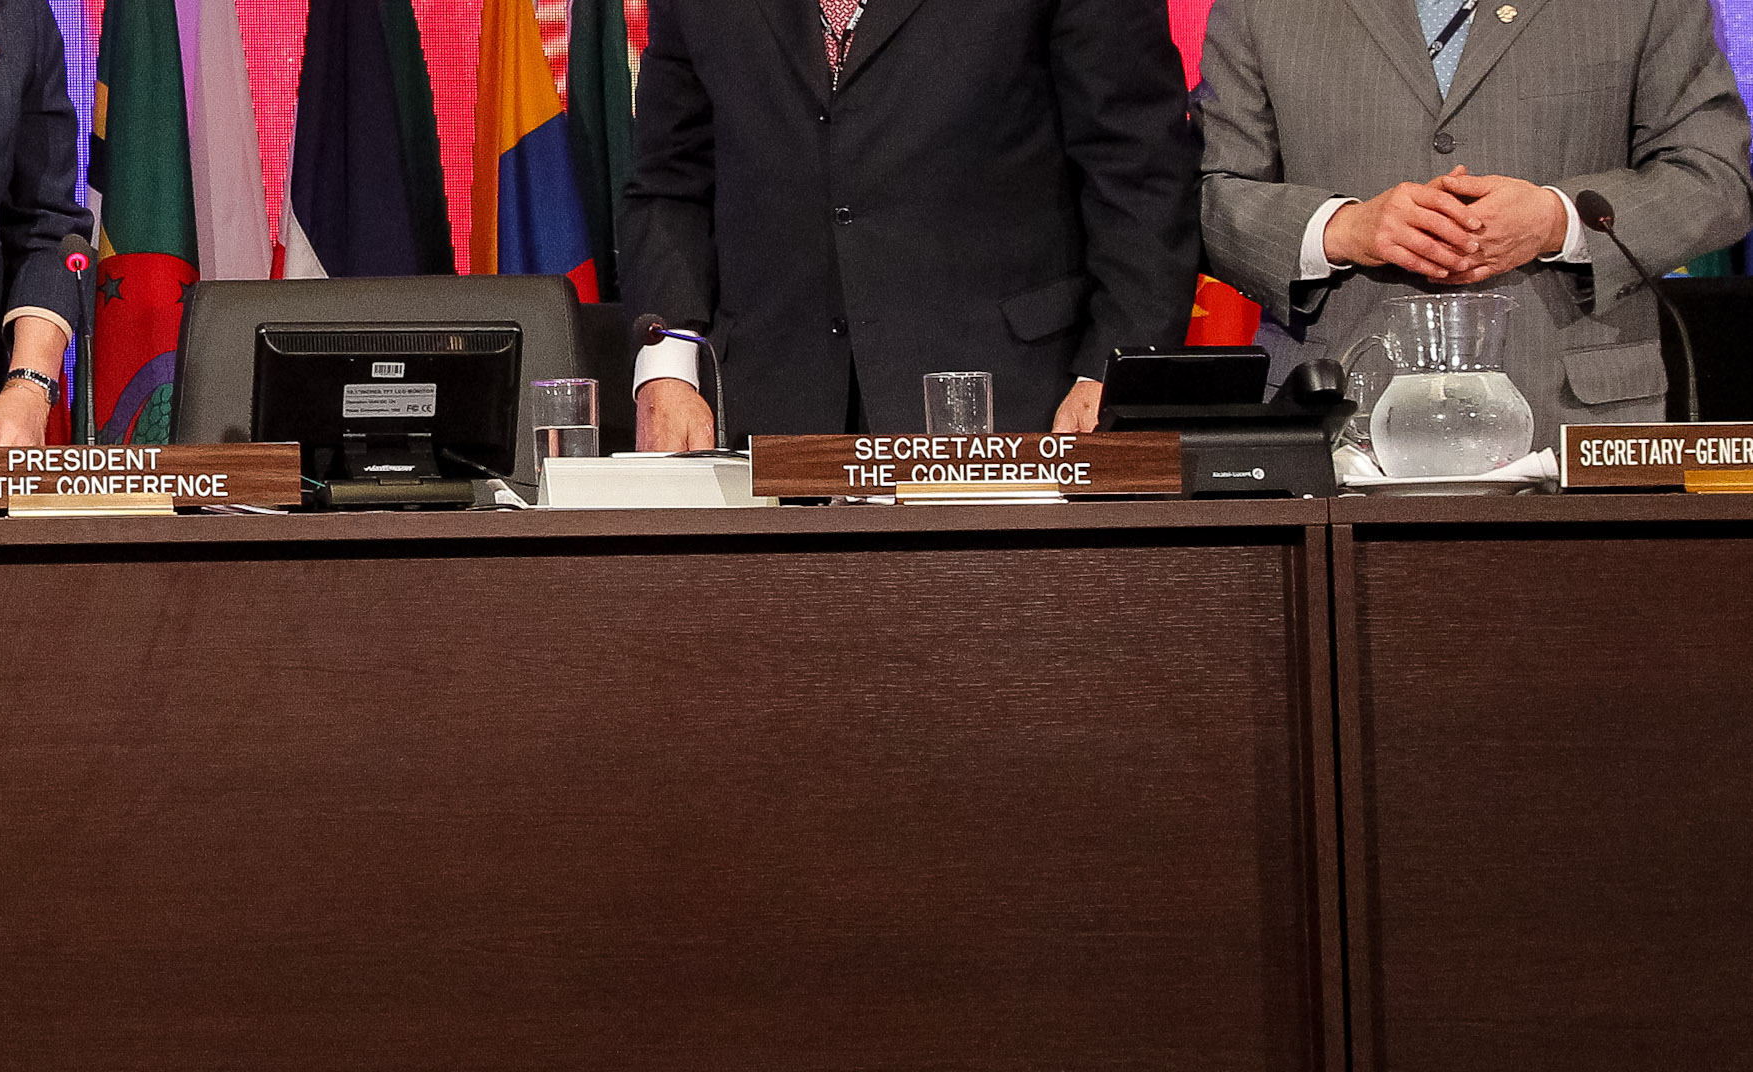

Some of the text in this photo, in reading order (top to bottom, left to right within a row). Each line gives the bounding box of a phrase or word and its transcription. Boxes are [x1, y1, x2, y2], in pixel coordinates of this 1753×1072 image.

[8, 448, 161, 472] PRESIDENT
[855, 436, 1077, 460] SECRETARY OF
[56, 474, 229, 496] CONFERENCE
[843, 462, 1092, 487] THE CONFERENCE
